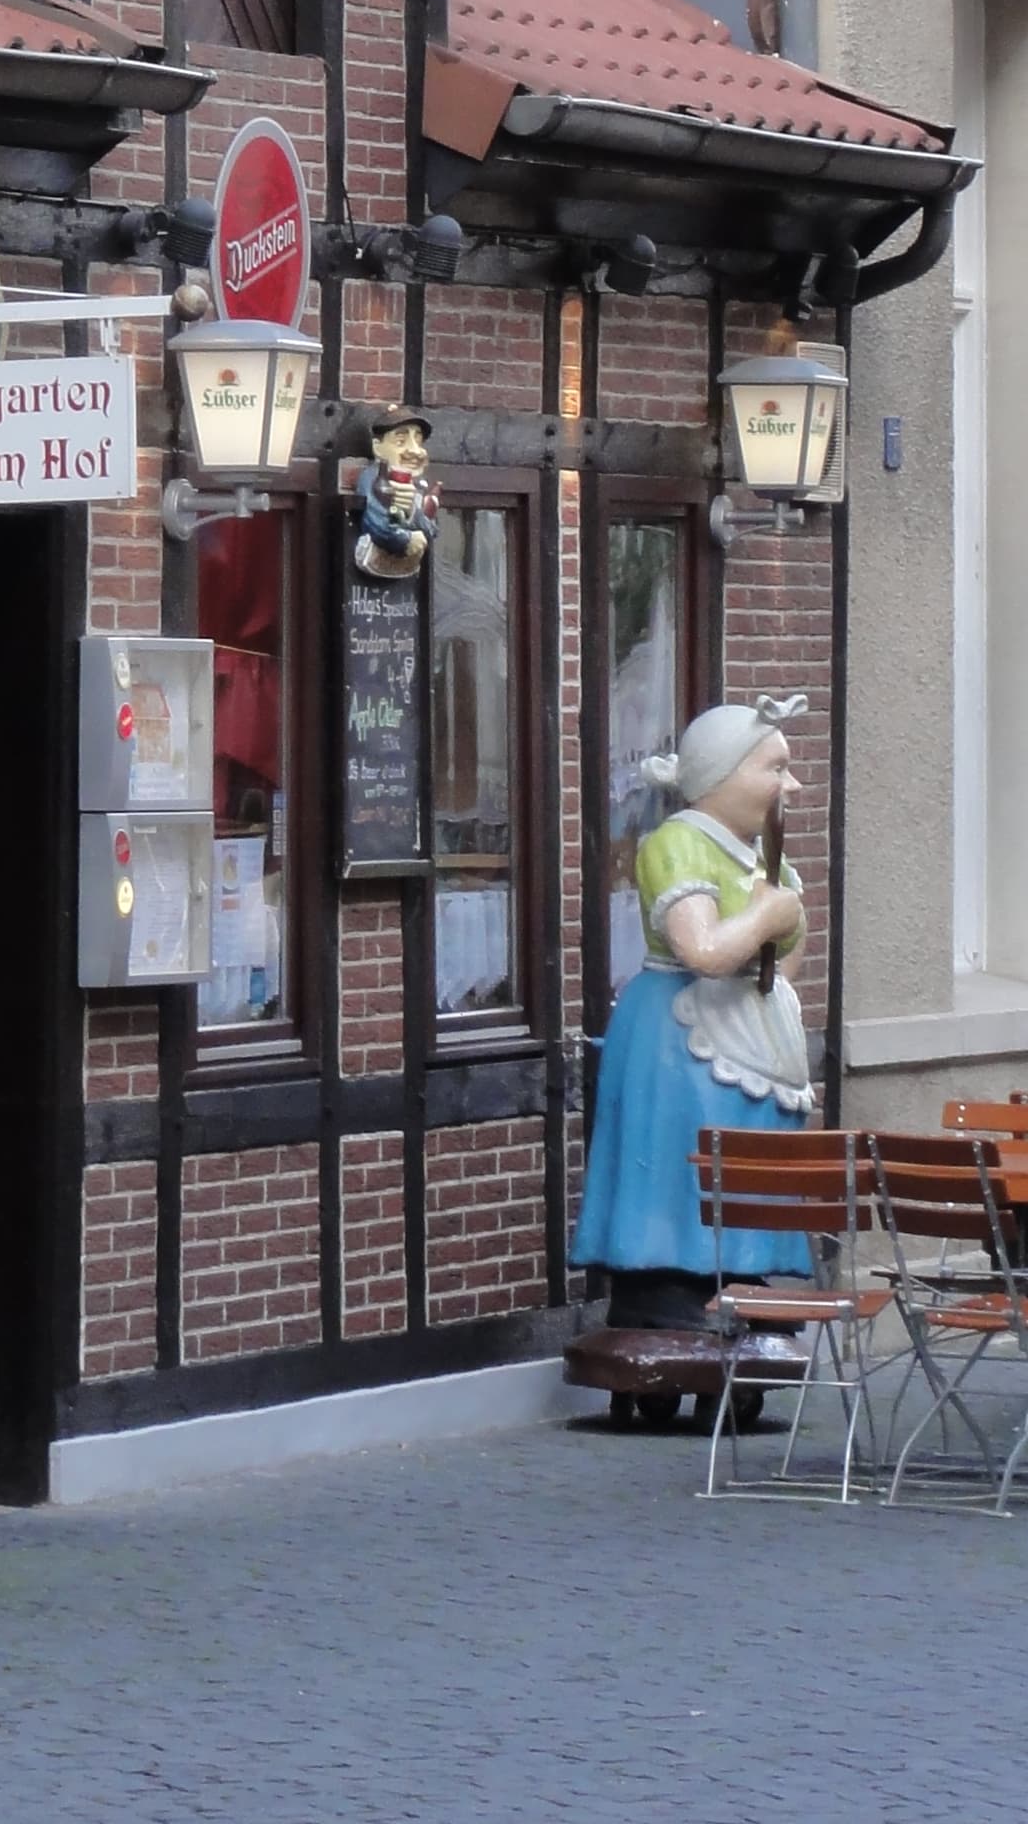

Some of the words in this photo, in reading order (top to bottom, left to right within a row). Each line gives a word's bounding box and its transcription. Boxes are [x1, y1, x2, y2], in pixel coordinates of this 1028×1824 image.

[226, 212, 297, 292] Duckstein
[202, 388, 258, 410] Lübzer
[746, 416, 797, 435] Lübzer
[42, 437, 113, 480] Hof
